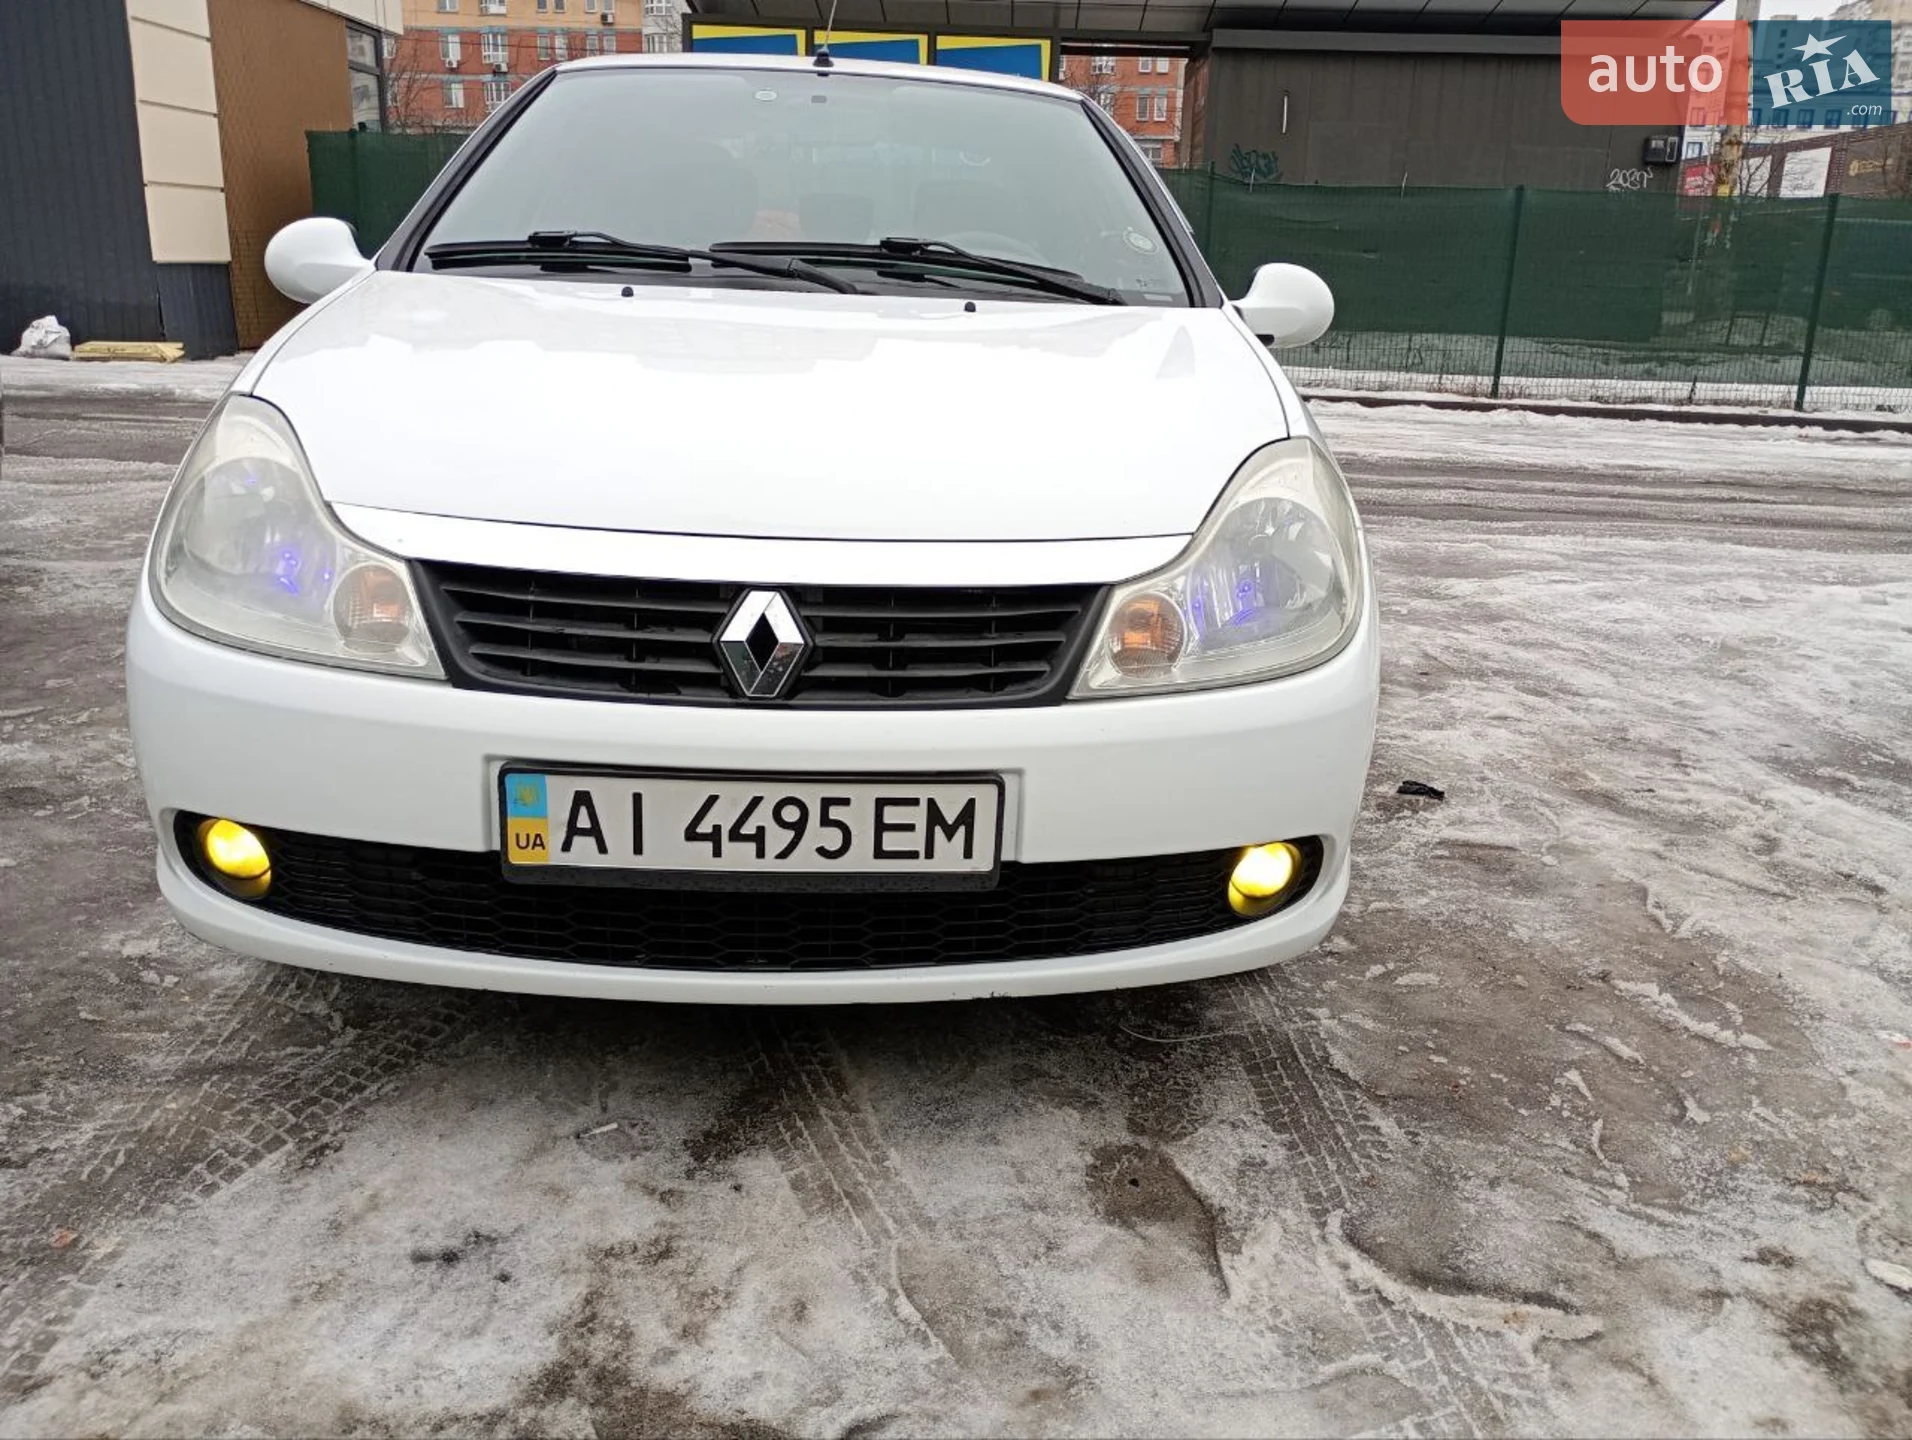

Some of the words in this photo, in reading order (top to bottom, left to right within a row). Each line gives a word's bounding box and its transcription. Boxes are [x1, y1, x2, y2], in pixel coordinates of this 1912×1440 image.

[515, 833, 546, 850] UA
[561, 789, 643, 855] AI
[684, 794, 852, 860] 4495
[873, 797, 976, 860] EM
